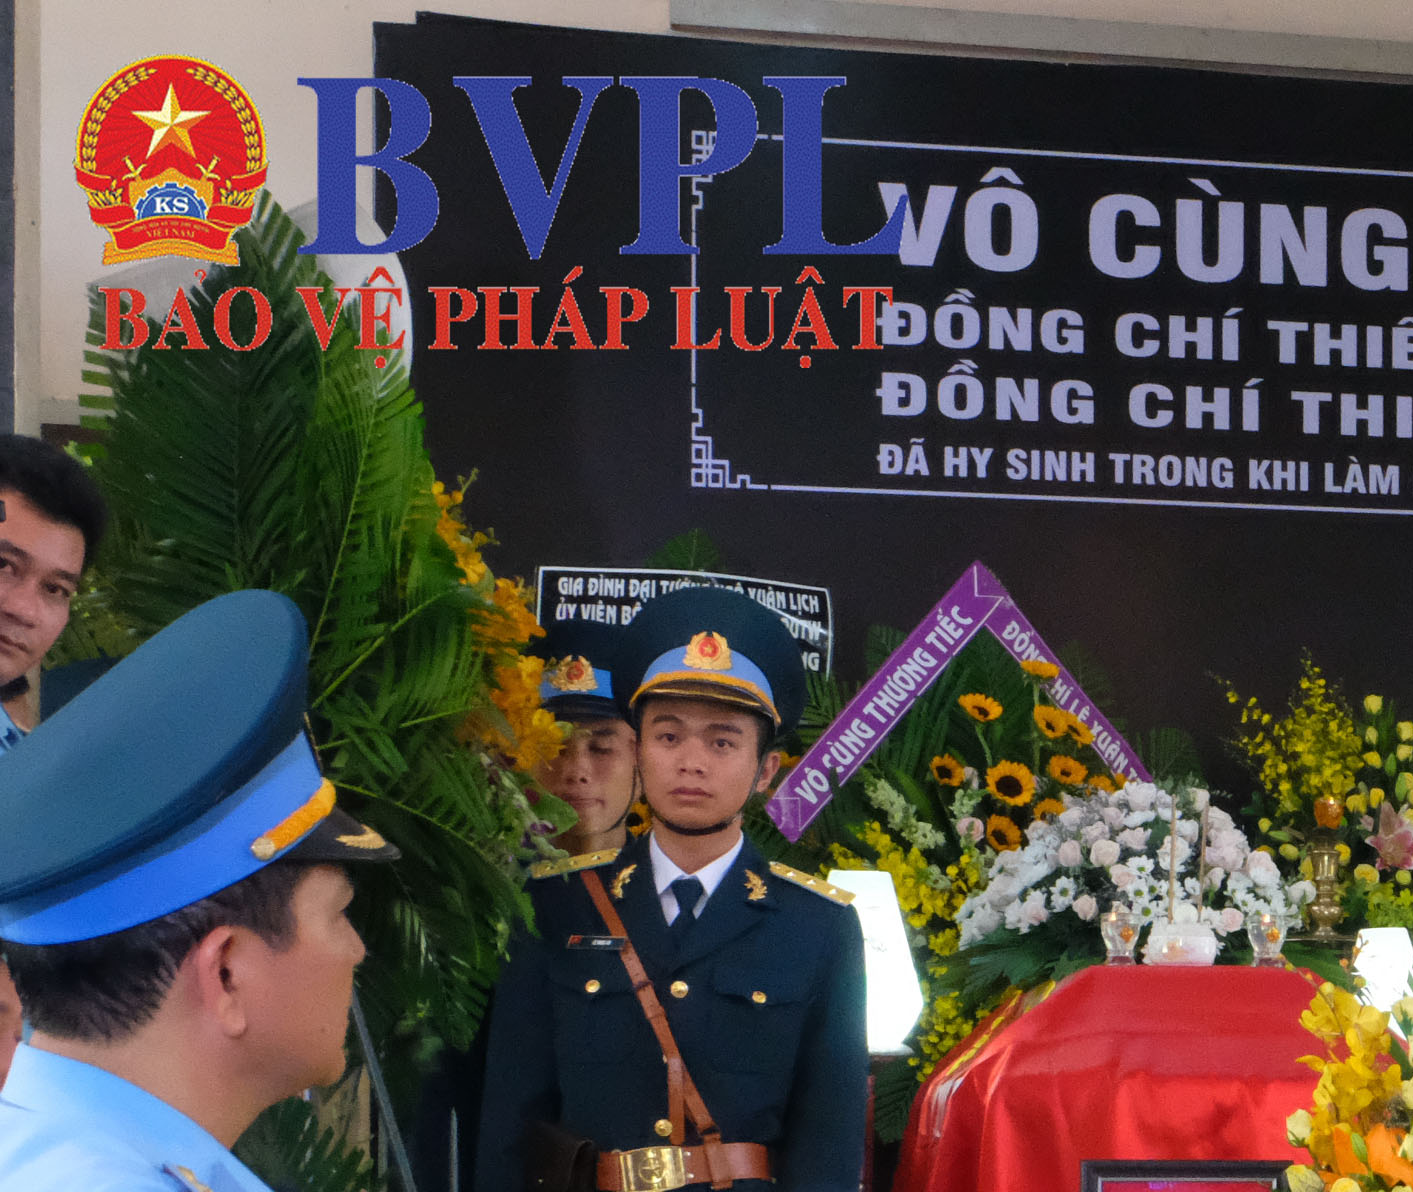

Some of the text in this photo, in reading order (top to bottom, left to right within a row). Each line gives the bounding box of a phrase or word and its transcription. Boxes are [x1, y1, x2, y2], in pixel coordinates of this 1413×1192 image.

[878, 167, 1039, 272] VÔ
[1089, 177, 1409, 292] CÙNG
[876, 289, 1085, 354] ĐỒNG
[1115, 308, 1242, 361] CHÍ
[876, 360, 1094, 424] ĐỒNG
[1129, 378, 1263, 431] CHÍ
[877, 438, 930, 476] ĐÃ
[944, 446, 994, 479] HY
[1006, 448, 1095, 483] SINH
[1109, 453, 1233, 488] TRONG
[1249, 459, 1309, 492] KHI
[1325, 456, 1400, 496] LÀM
[556, 597, 577, 621] ỦY
[581, 600, 617, 625] VIÊN
[558, 577, 583, 597] GIA
[588, 575, 625, 598] ĐÌNH
[629, 579, 656, 603] ĐẠI
[788, 593, 820, 616] LỊCH
[795, 605, 973, 805] VÔ CÙNG THƯƠNG TIẾC
[1051, 678, 1074, 705] HÍ
